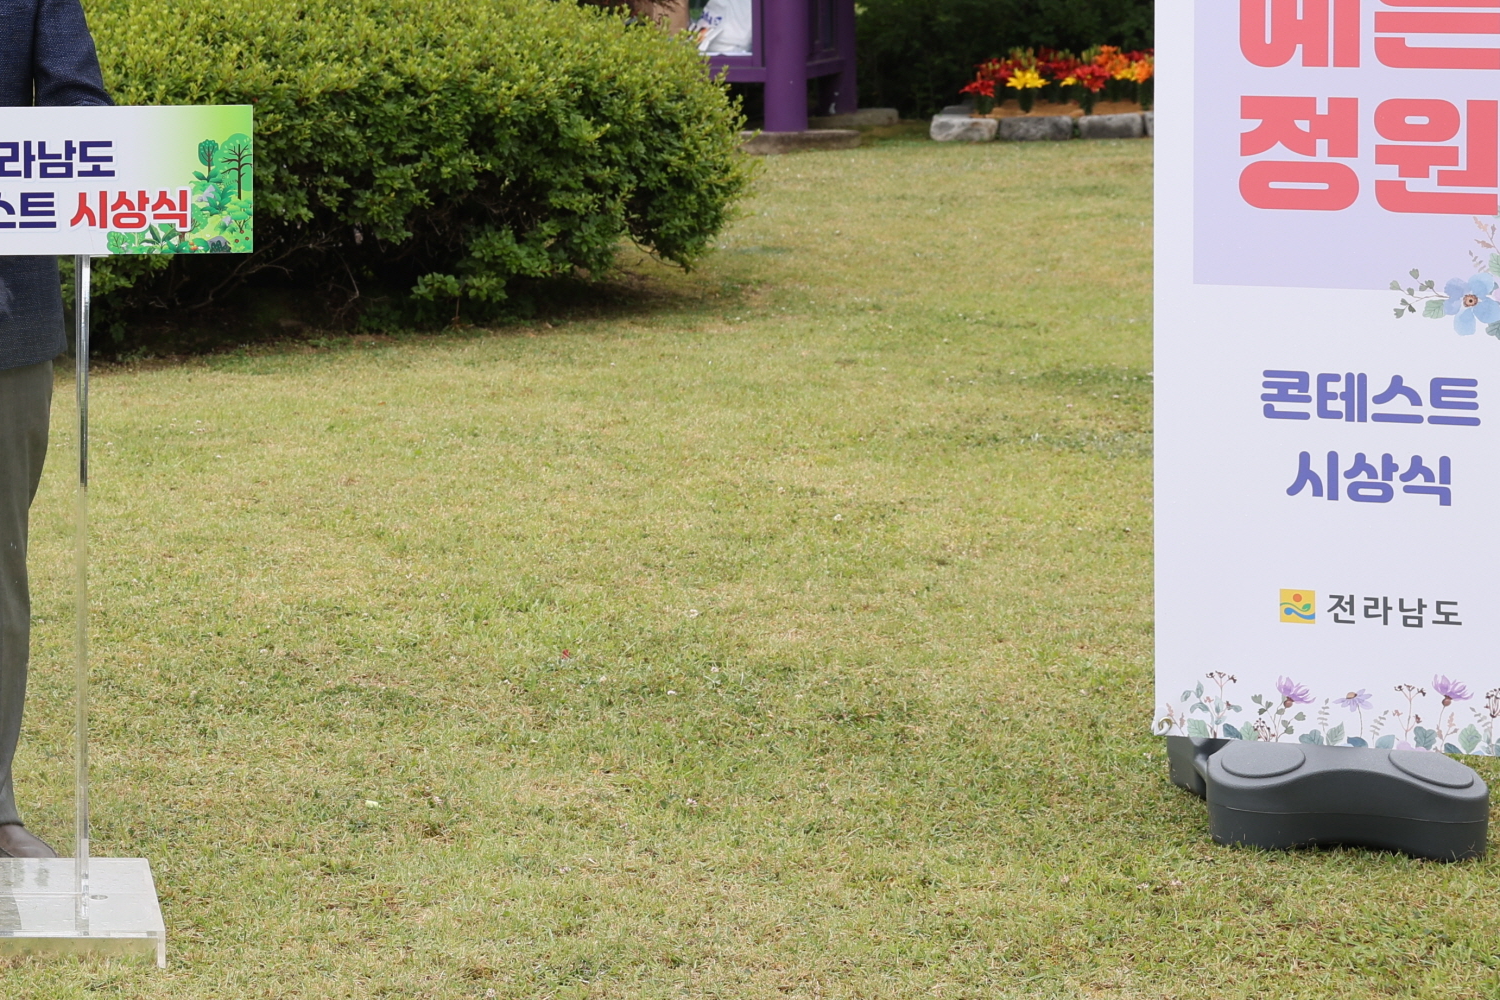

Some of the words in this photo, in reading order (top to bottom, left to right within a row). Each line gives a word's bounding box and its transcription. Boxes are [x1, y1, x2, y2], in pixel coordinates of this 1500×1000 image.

[1238, 95, 1499, 216] 정원
[70, 189, 188, 229] 시상식
[1260, 369, 1481, 427] 콘테스트
[1286, 450, 1452, 506] 시상식
[1326, 594, 1463, 628] 전라남도
